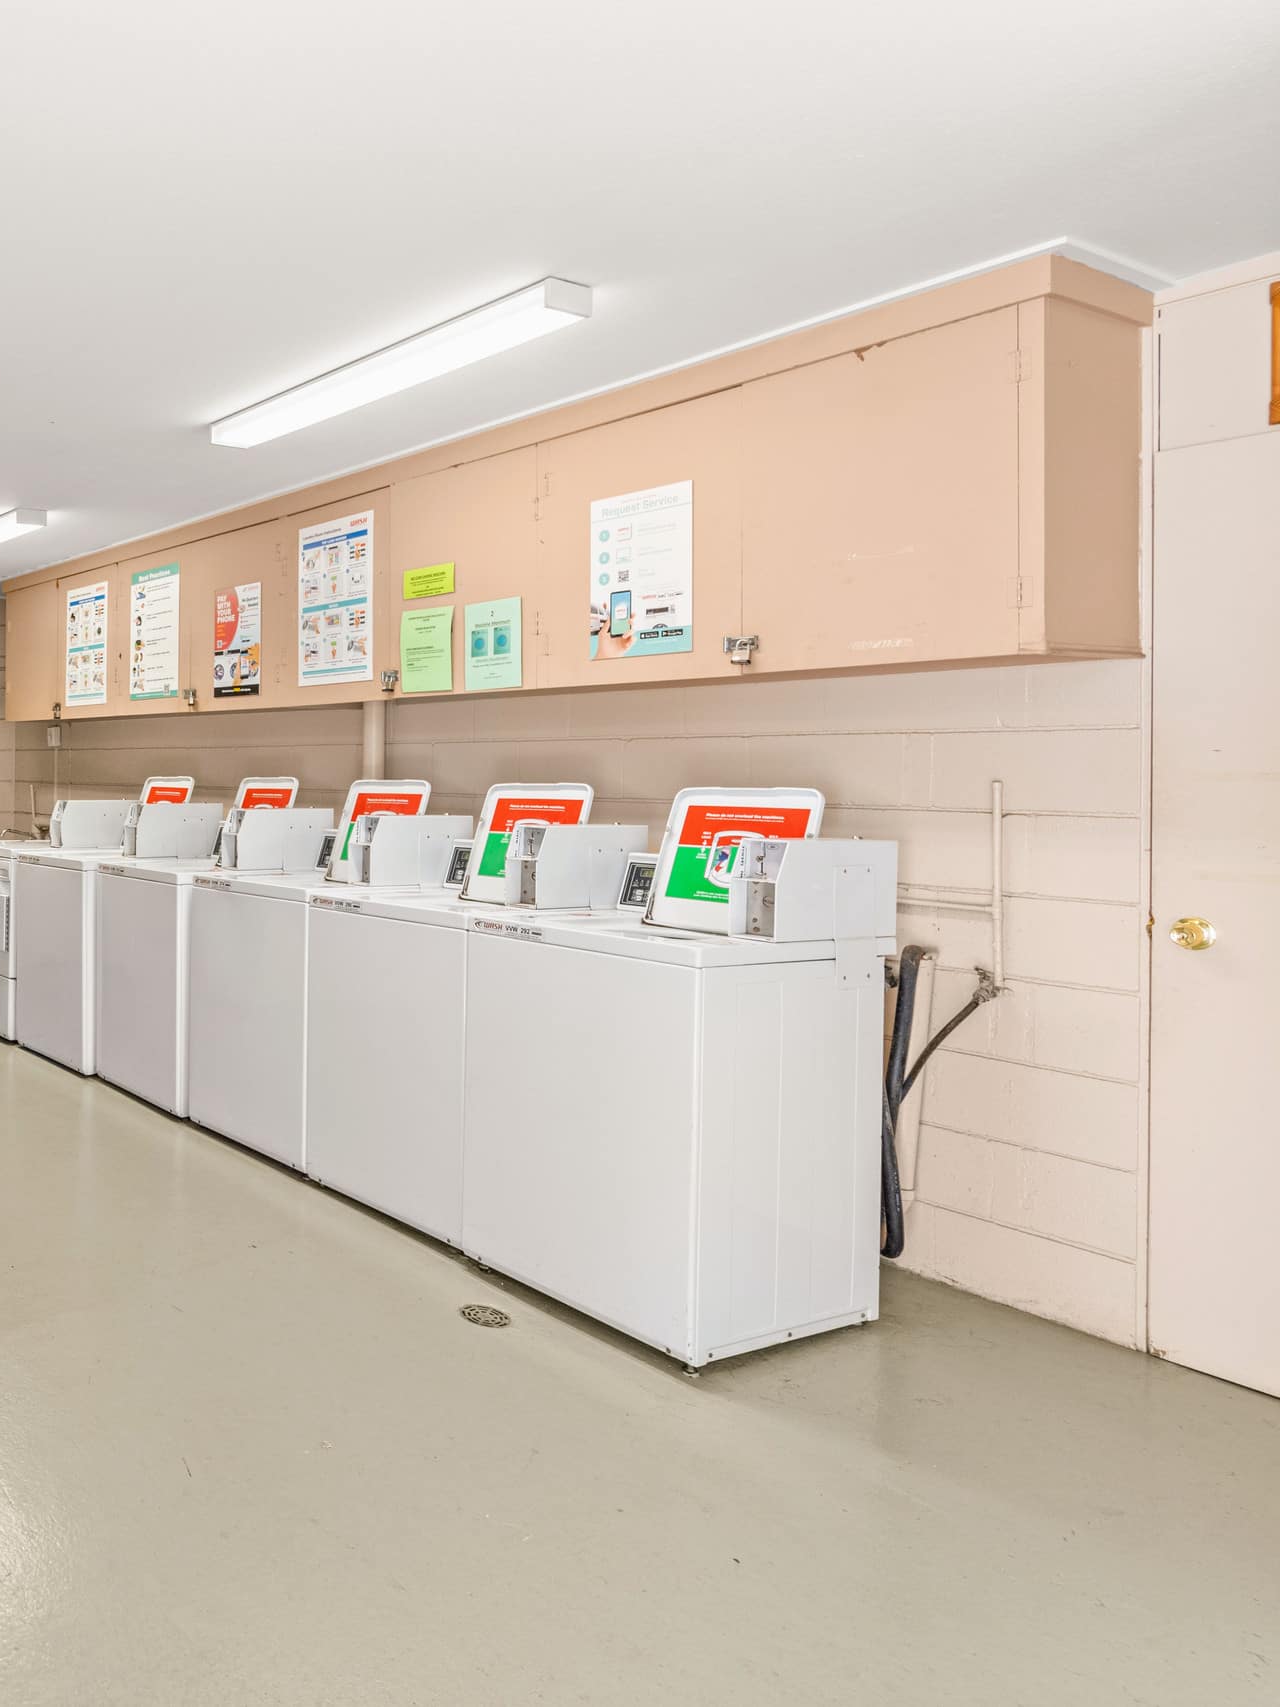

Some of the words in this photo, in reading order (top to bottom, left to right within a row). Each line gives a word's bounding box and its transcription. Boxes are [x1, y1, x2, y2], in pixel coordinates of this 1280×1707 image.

[601, 502, 641, 519] Request
[642, 495, 679, 510] Service
[217, 614, 236, 624] PHONE
